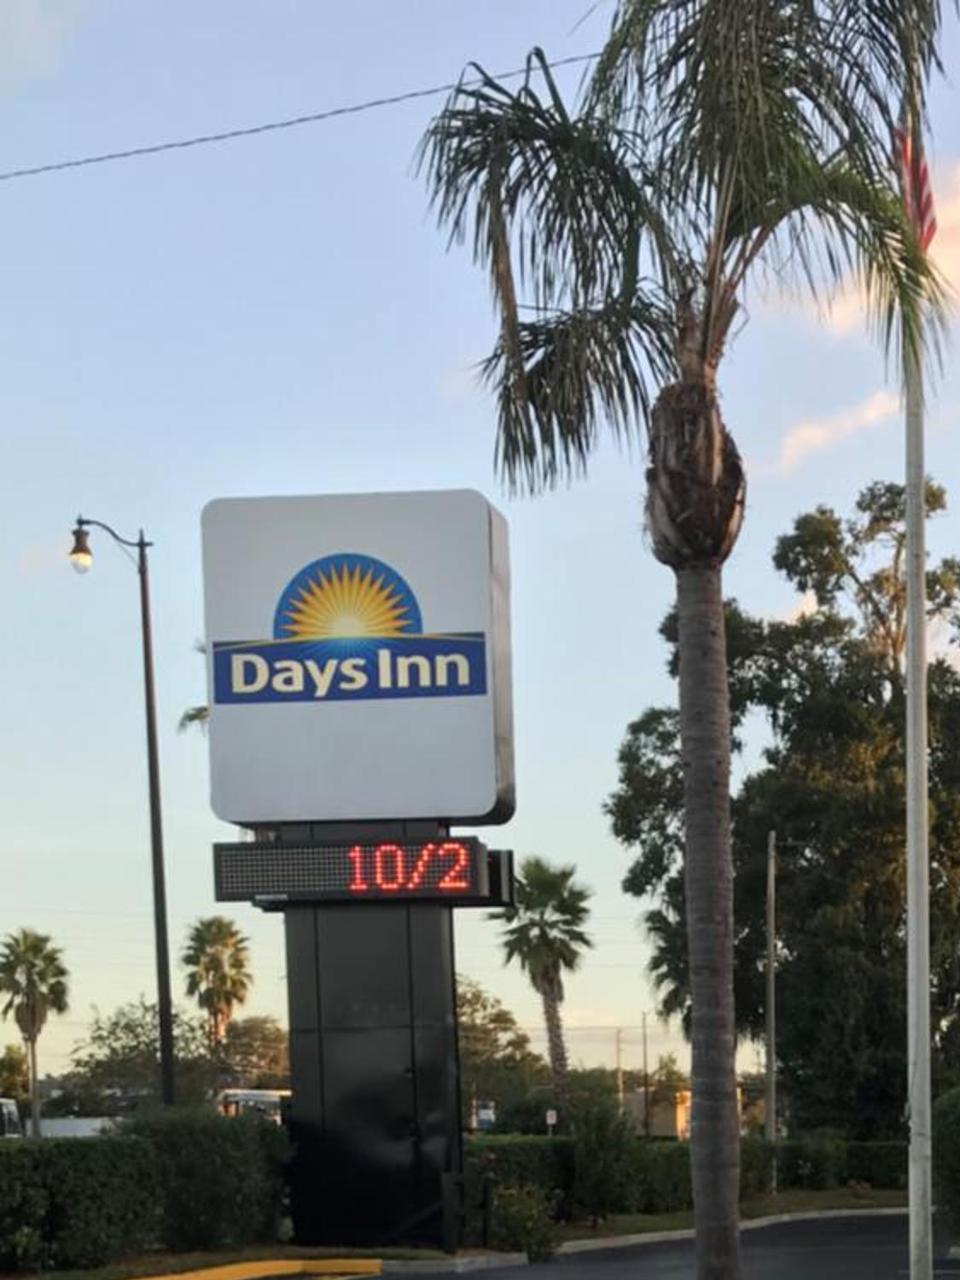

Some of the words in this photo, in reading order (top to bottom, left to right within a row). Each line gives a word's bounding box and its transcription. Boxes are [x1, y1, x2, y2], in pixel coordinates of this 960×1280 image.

[231, 652, 368, 698] Days
[379, 649, 470, 689] Inn
[348, 842, 470, 892] 10/2
